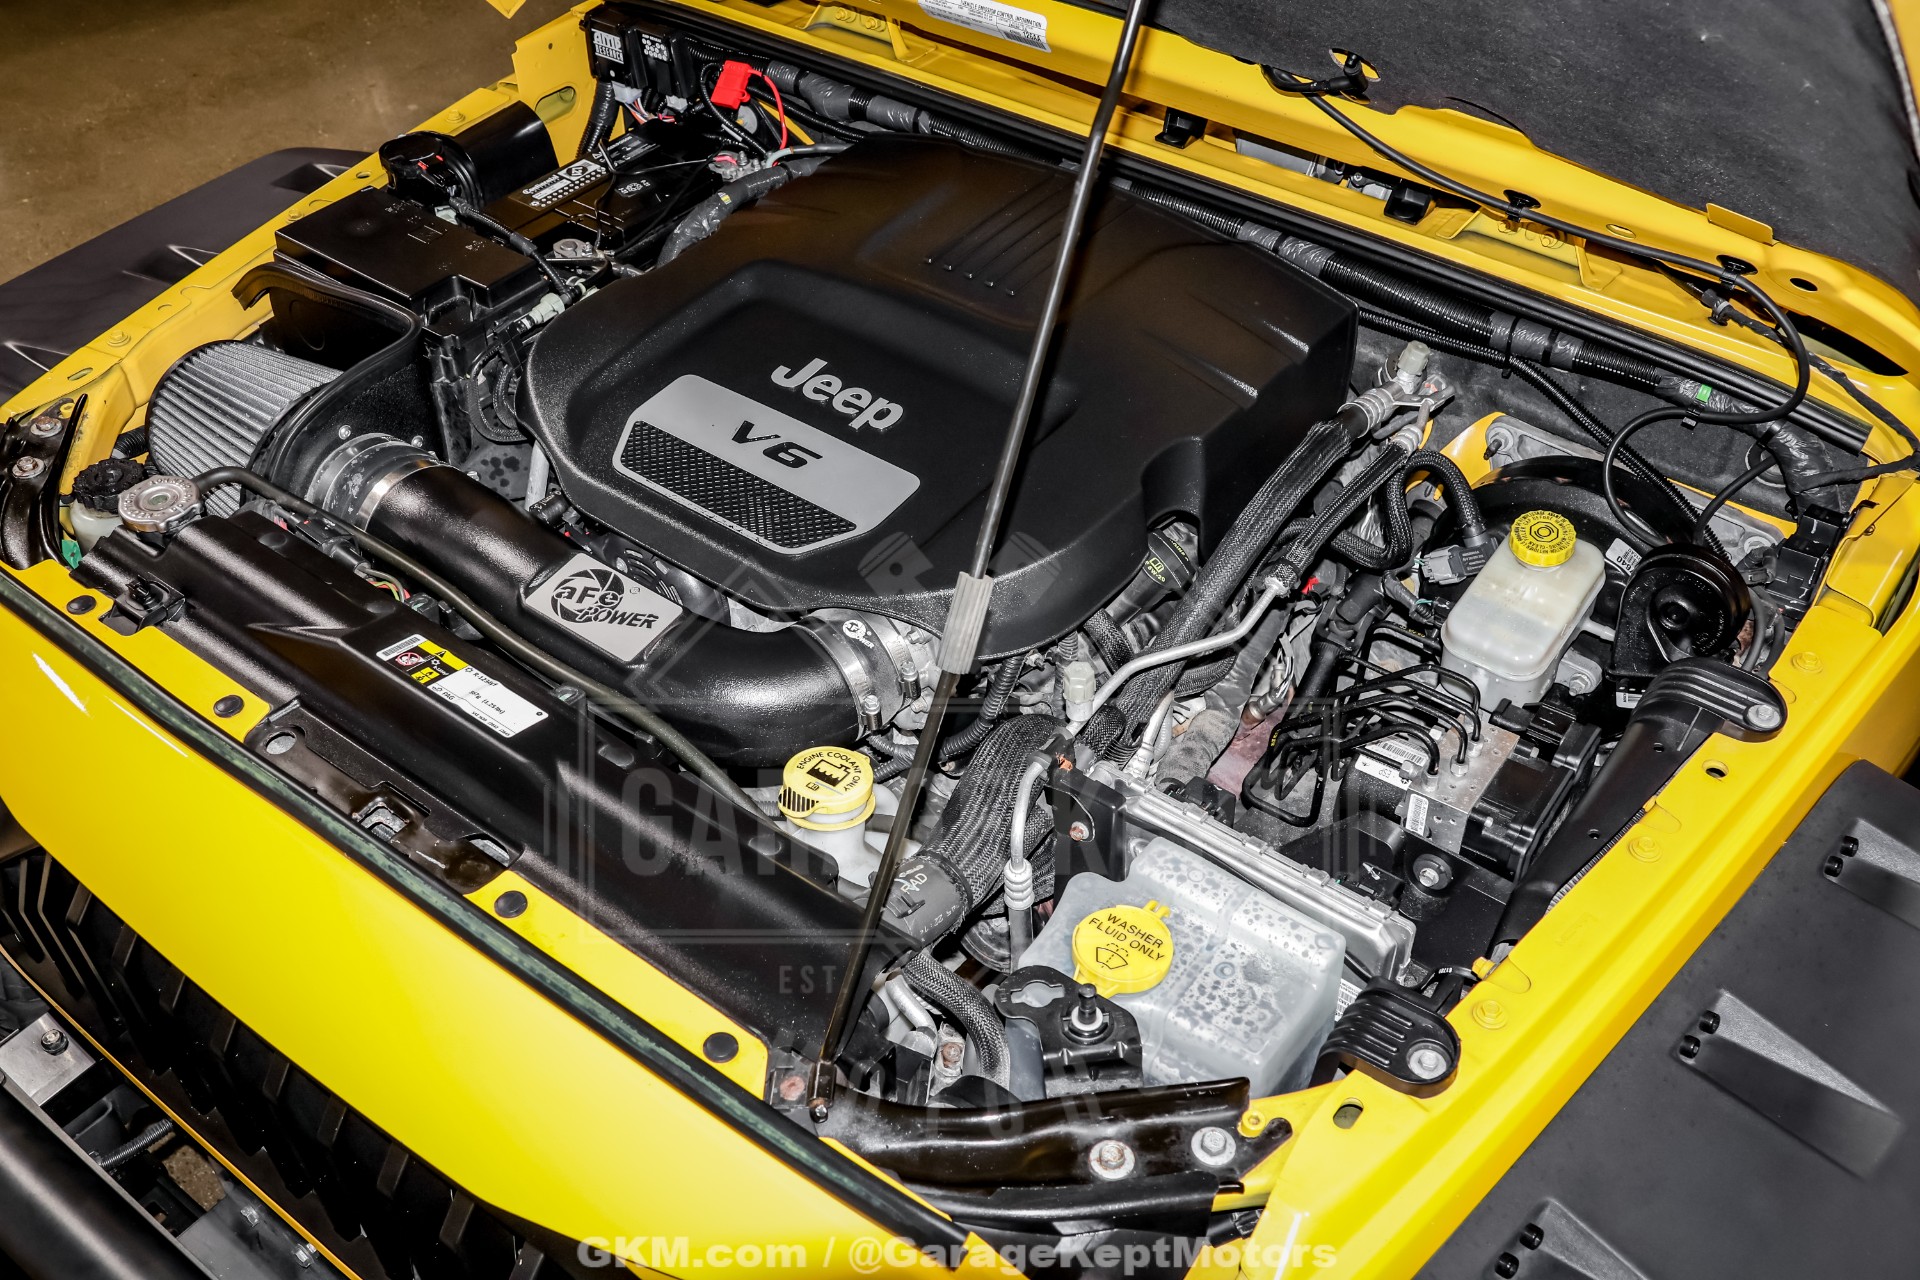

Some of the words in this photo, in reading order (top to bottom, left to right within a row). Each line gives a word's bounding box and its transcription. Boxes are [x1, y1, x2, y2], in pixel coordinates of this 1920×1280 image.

[770, 357, 904, 431] Jeep
[732, 420, 823, 469] V6
[554, 586, 620, 606] aFe
[575, 606, 660, 629] POWER
[796, 751, 825, 770] ENGINE
[826, 751, 862, 774] COOLANT
[843, 775, 861, 792] ONLY
[900, 873, 928, 895] RAD
[1088, 917, 1127, 942] FLUID
[1129, 940, 1165, 961] ONLY
[1107, 913, 1164, 949] WASHER
